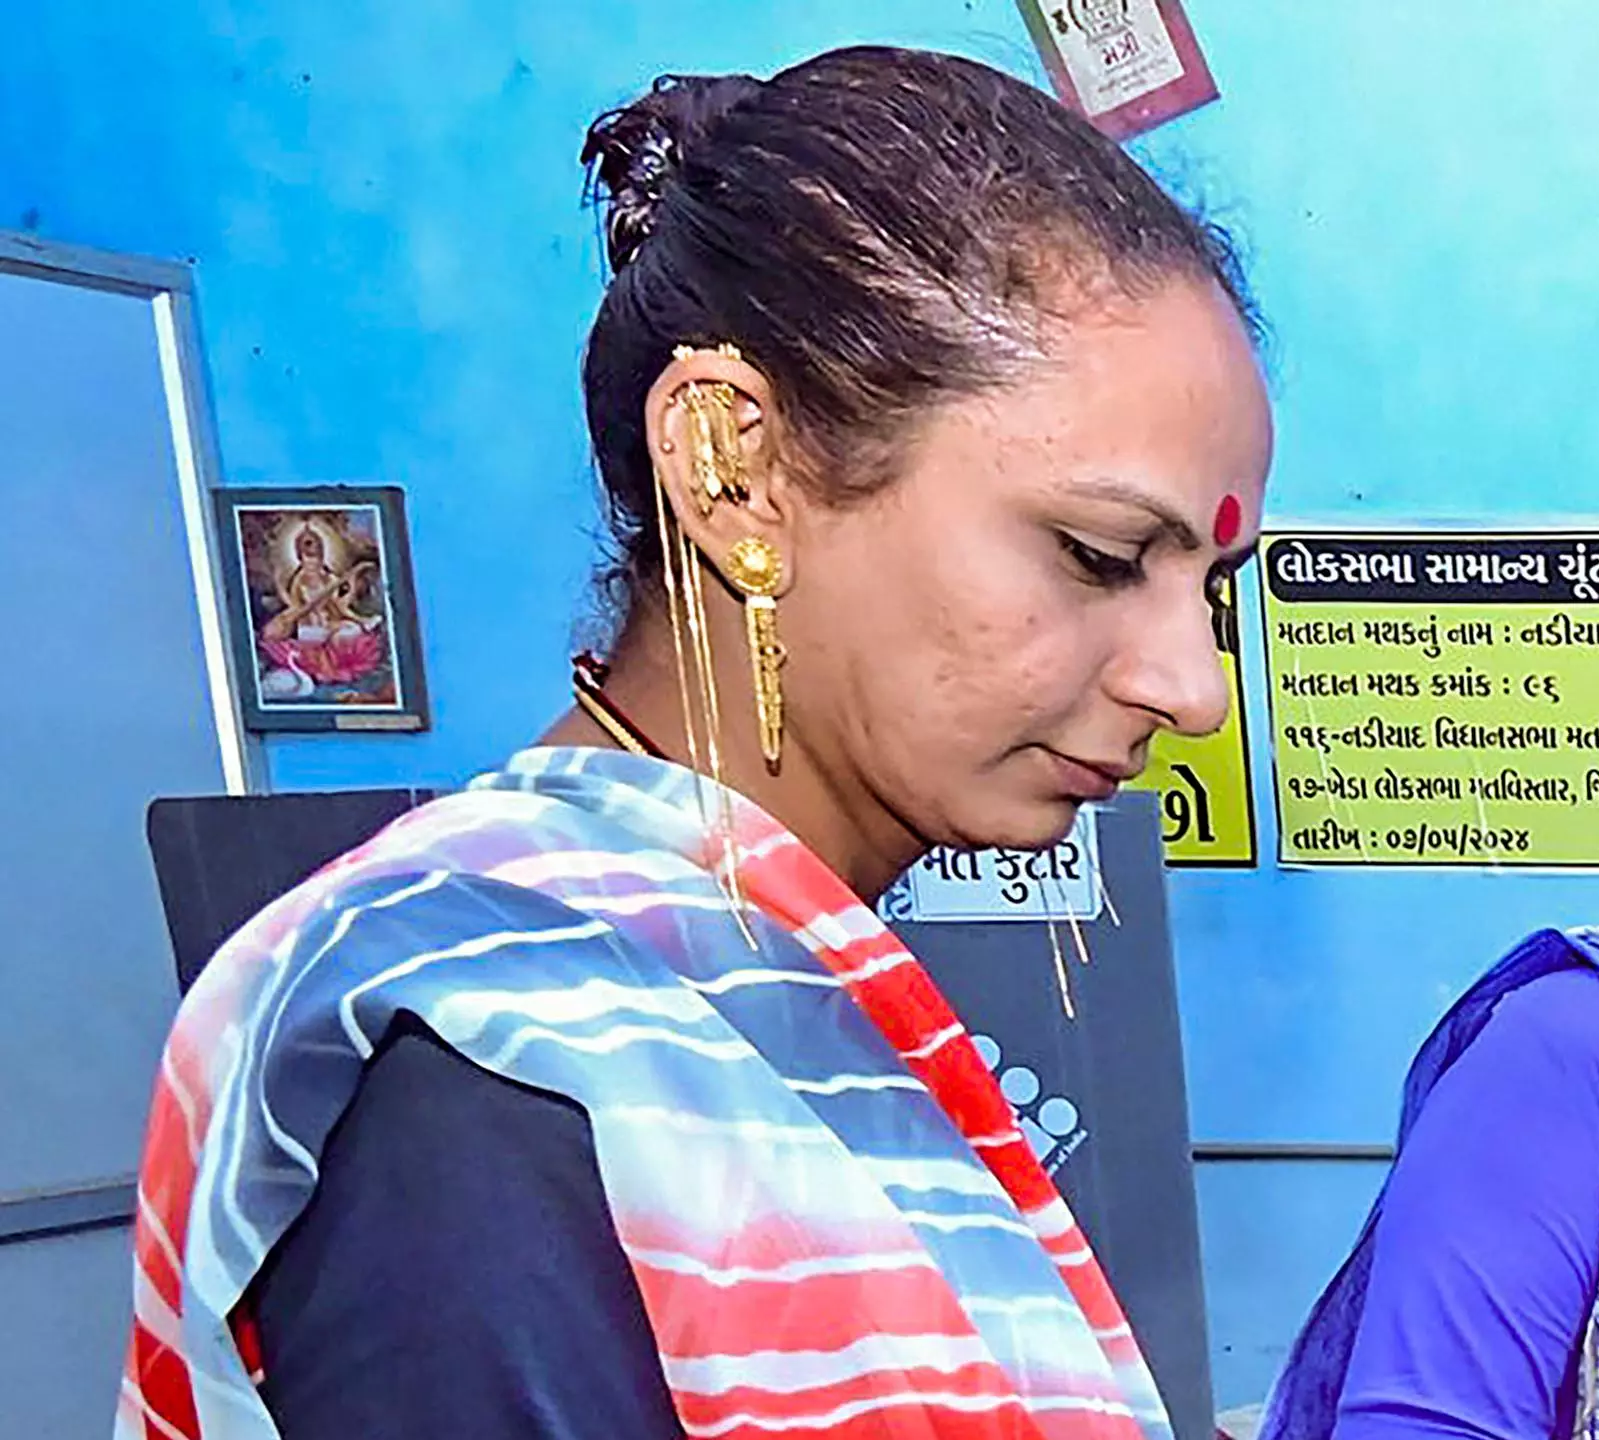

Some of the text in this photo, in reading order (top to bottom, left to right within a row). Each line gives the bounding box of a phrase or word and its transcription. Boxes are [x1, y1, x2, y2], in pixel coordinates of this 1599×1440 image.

[1277, 541, 1416, 583] લોકસભા
[1425, 554, 1549, 584] સામાન્ય
[1278, 621, 1355, 645] મતદાન
[1447, 623, 1493, 646] નામ
[1282, 674, 1359, 697] મતદાન
[1367, 673, 1420, 697] મથક
[1435, 716, 1557, 749] વિધાનસભા
[1374, 767, 1462, 800] લોકસભા
[1292, 818, 1361, 850] તારીખ
